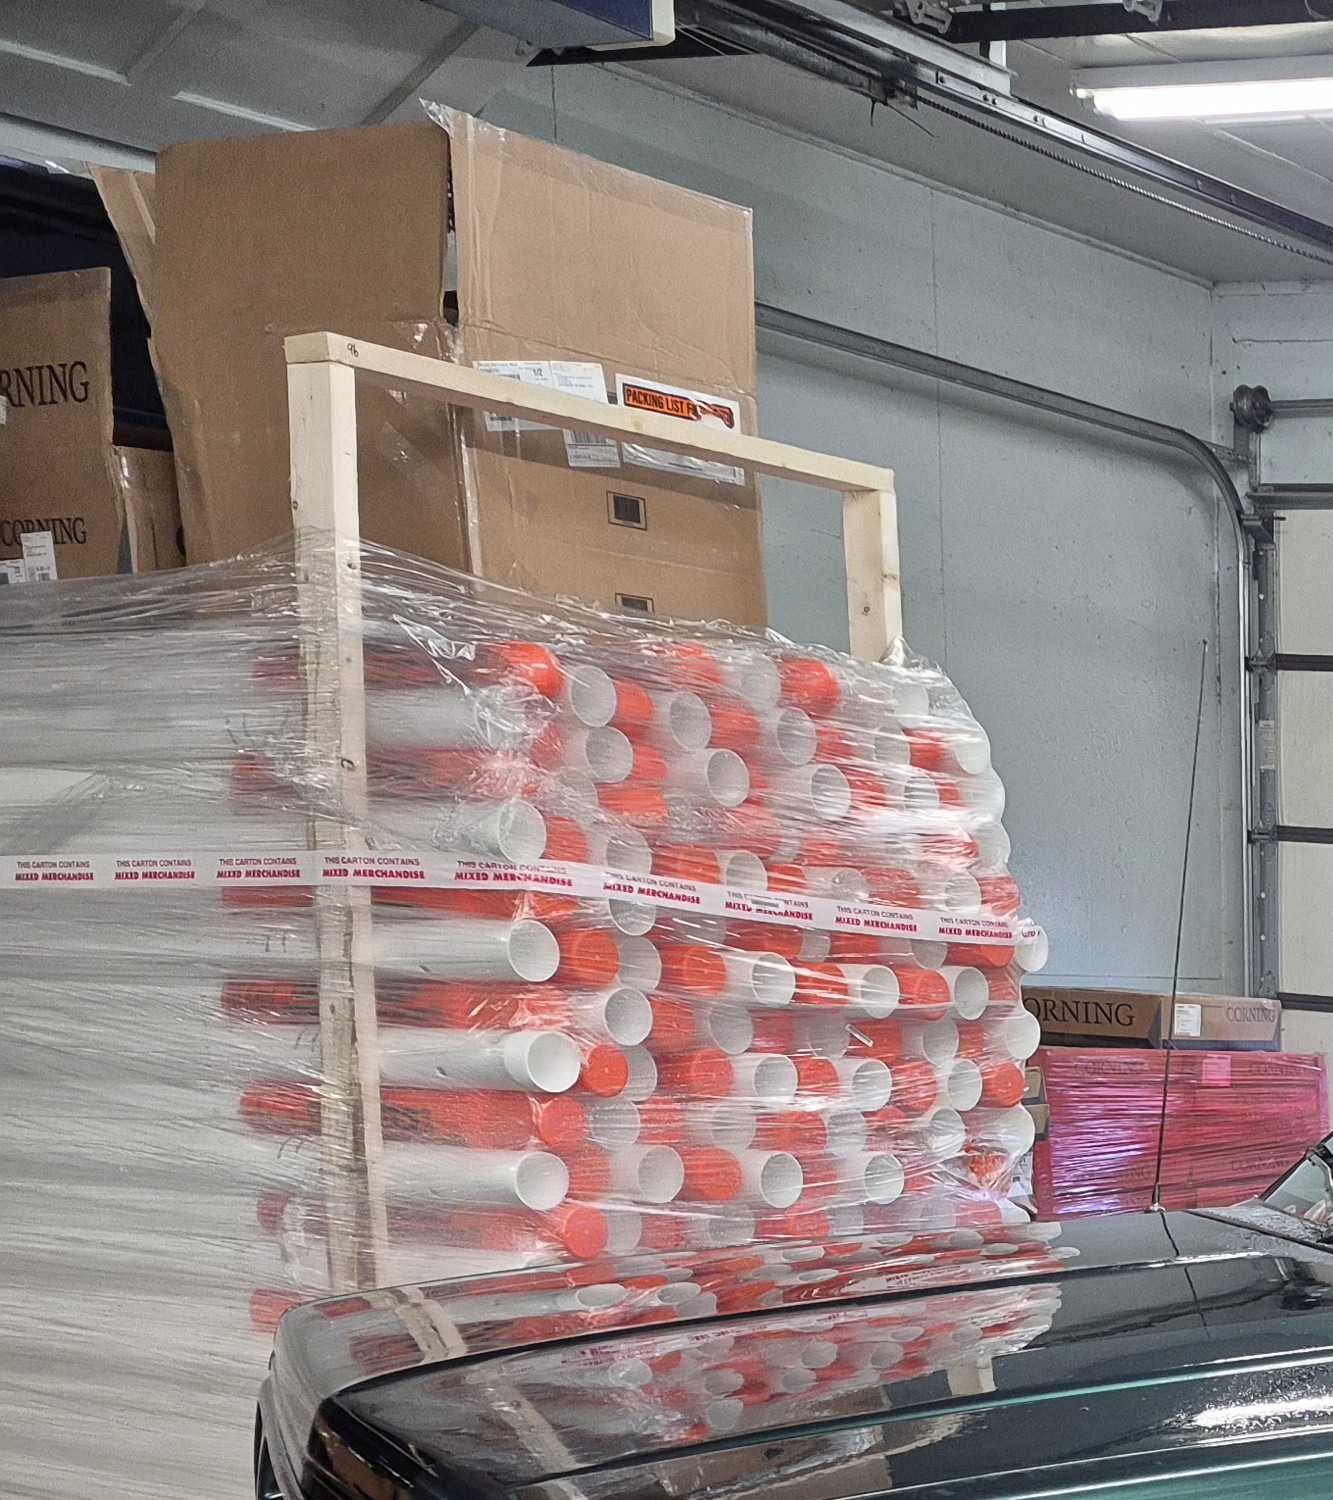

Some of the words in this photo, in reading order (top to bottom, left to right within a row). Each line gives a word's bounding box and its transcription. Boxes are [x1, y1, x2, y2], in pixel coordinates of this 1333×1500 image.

[626, 388, 664, 409] PACKING
[666, 398, 684, 414] LIST
[59, 860, 90, 868] CONTAINS
[159, 859, 192, 867] CONTAINS
[219, 858, 233, 866] THIS
[234, 858, 260, 866] CARTON
[262, 857, 297, 866] CONTAINS
[341, 857, 376, 865] CARTON
[377, 857, 420, 866] CONTAINS
[457, 860, 476, 869] THIS
[479, 862, 517, 871] CARTON
[15, 872, 39, 881] MIXED
[41, 872, 94, 881] MERCHANDISE
[115, 871, 139, 880] MIXED
[142, 870, 195, 879] MERCHANDISE
[216, 870, 242, 879] MIXED
[245, 869, 301, 878] MERCHANDISE
[322, 868, 349, 877] MIXED
[353, 869, 425, 880] MERCHANDISE
[454, 872, 489, 881] MIXED
[626, 875, 657, 886] CARTON
[659, 880, 697, 892] CONTAINS
[603, 882, 634, 894] MIXED
[637, 886, 701, 904] MERCHANDISE
[837, 906, 851, 914] THIS
[853, 907, 880, 917] CARTON
[881, 911, 913, 920] CONTAINS
[835, 916, 861, 927] MIXED
[863, 919, 917, 933] MERCHANDISE
[938, 927, 962, 936] MIXED
[1227, 1007, 1275, 1022] CORNING
